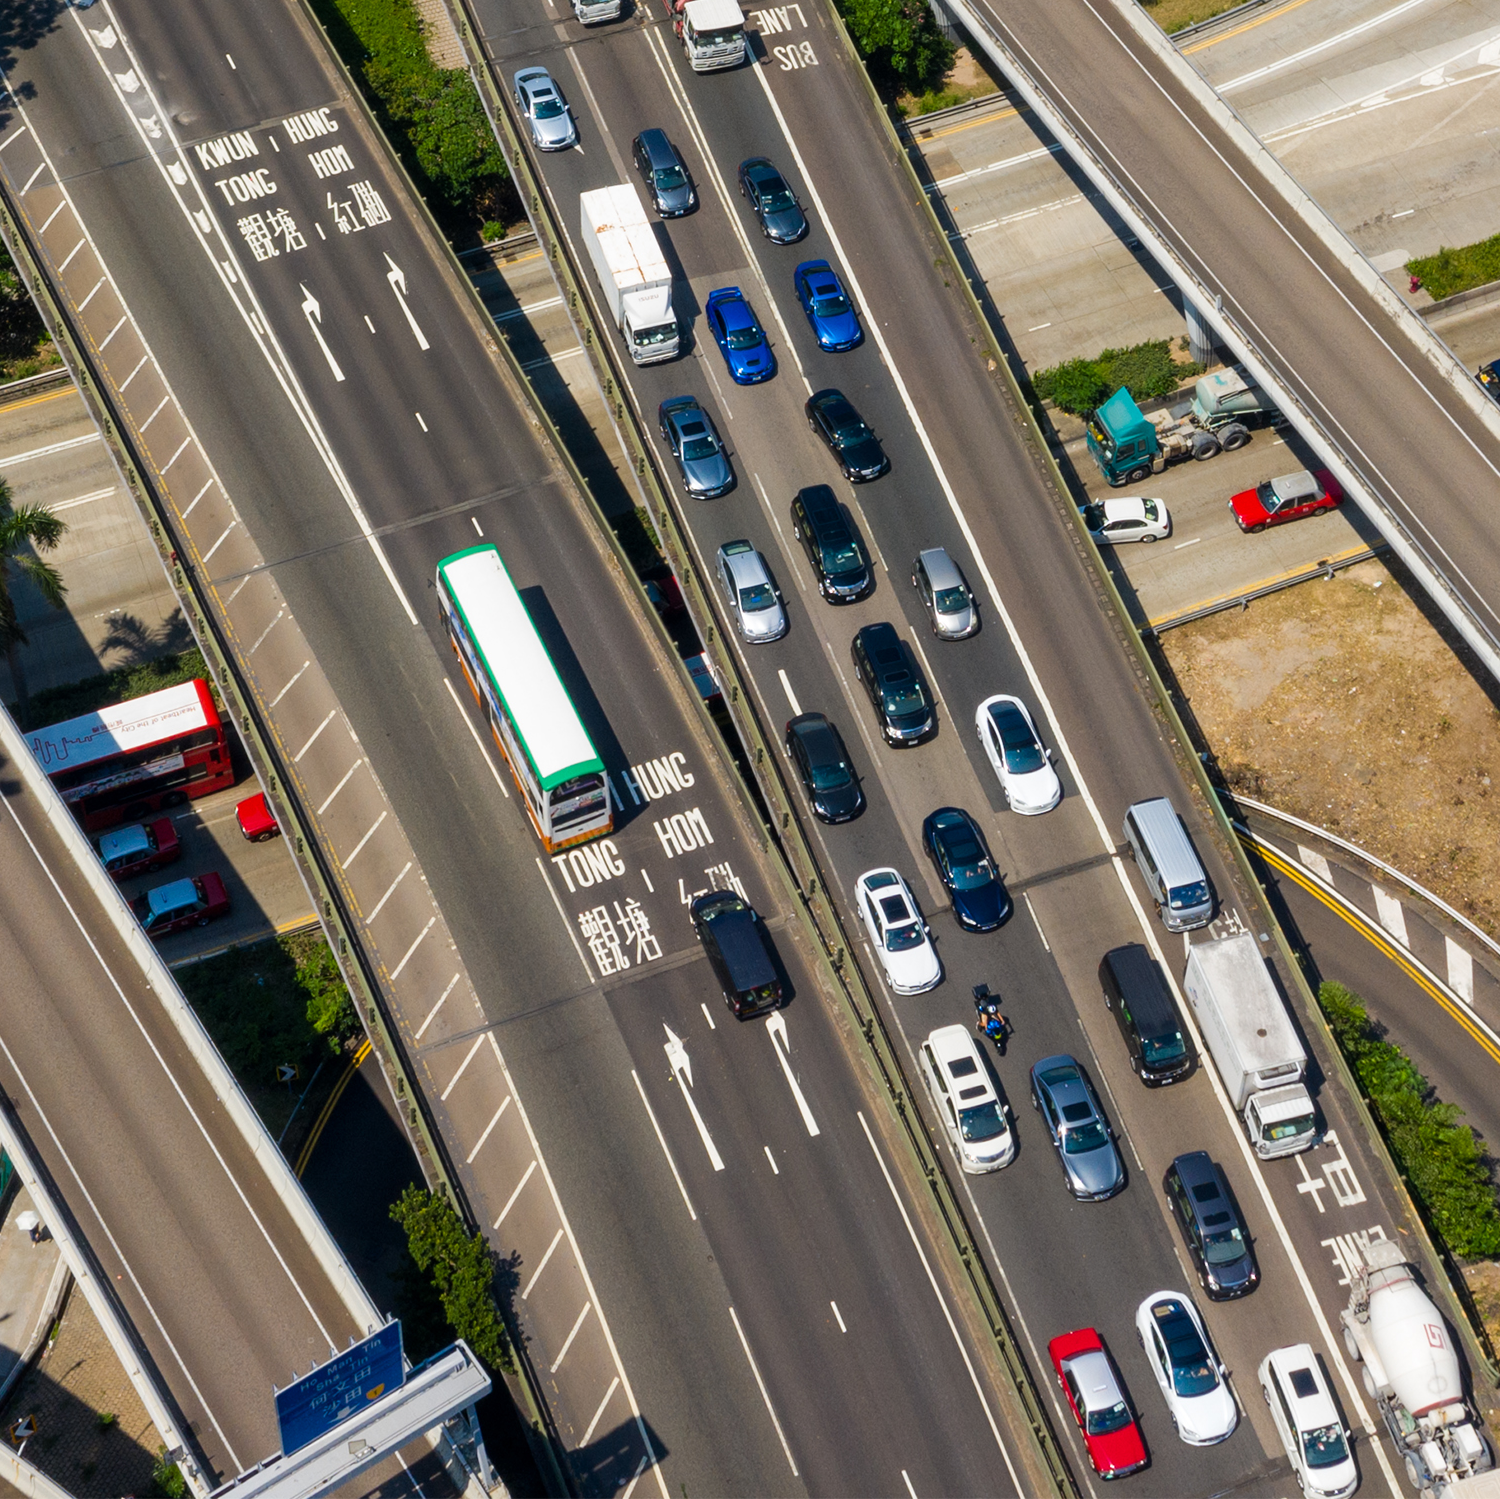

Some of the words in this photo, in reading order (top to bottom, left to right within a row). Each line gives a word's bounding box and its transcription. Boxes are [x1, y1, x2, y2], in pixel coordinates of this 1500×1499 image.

[749, 4, 808, 37] LANE
[773, 40, 819, 72] BUS
[282, 106, 340, 145] HUNG
[194, 130, 260, 171] KWUN
[307, 144, 356, 180] HOM
[214, 167, 278, 207] TONG
[326, 179, 392, 235] 紅磡
[236, 207, 308, 263] 觀塘
[638, 294, 660, 302] ISUZU
[120, 723, 136, 733] City
[137, 720, 150, 728] the
[160, 706, 197, 721] Heartbeat
[621, 751, 695, 806] HUNG
[653, 807, 715, 860] HOM
[551, 839, 626, 894] TONG
[577, 897, 663, 977] 觀塘
[1294, 1128, 1368, 1214] 巴士
[300, 1378, 317, 1393] Ho
[326, 1356, 352, 1376] Man
[362, 1338, 381, 1353] Tin
[316, 1374, 339, 1392] Sha
[349, 1355, 368, 1371] Tin
[309, 1364, 371, 1410] 何文田
[322, 1385, 362, 1418] 沙田
